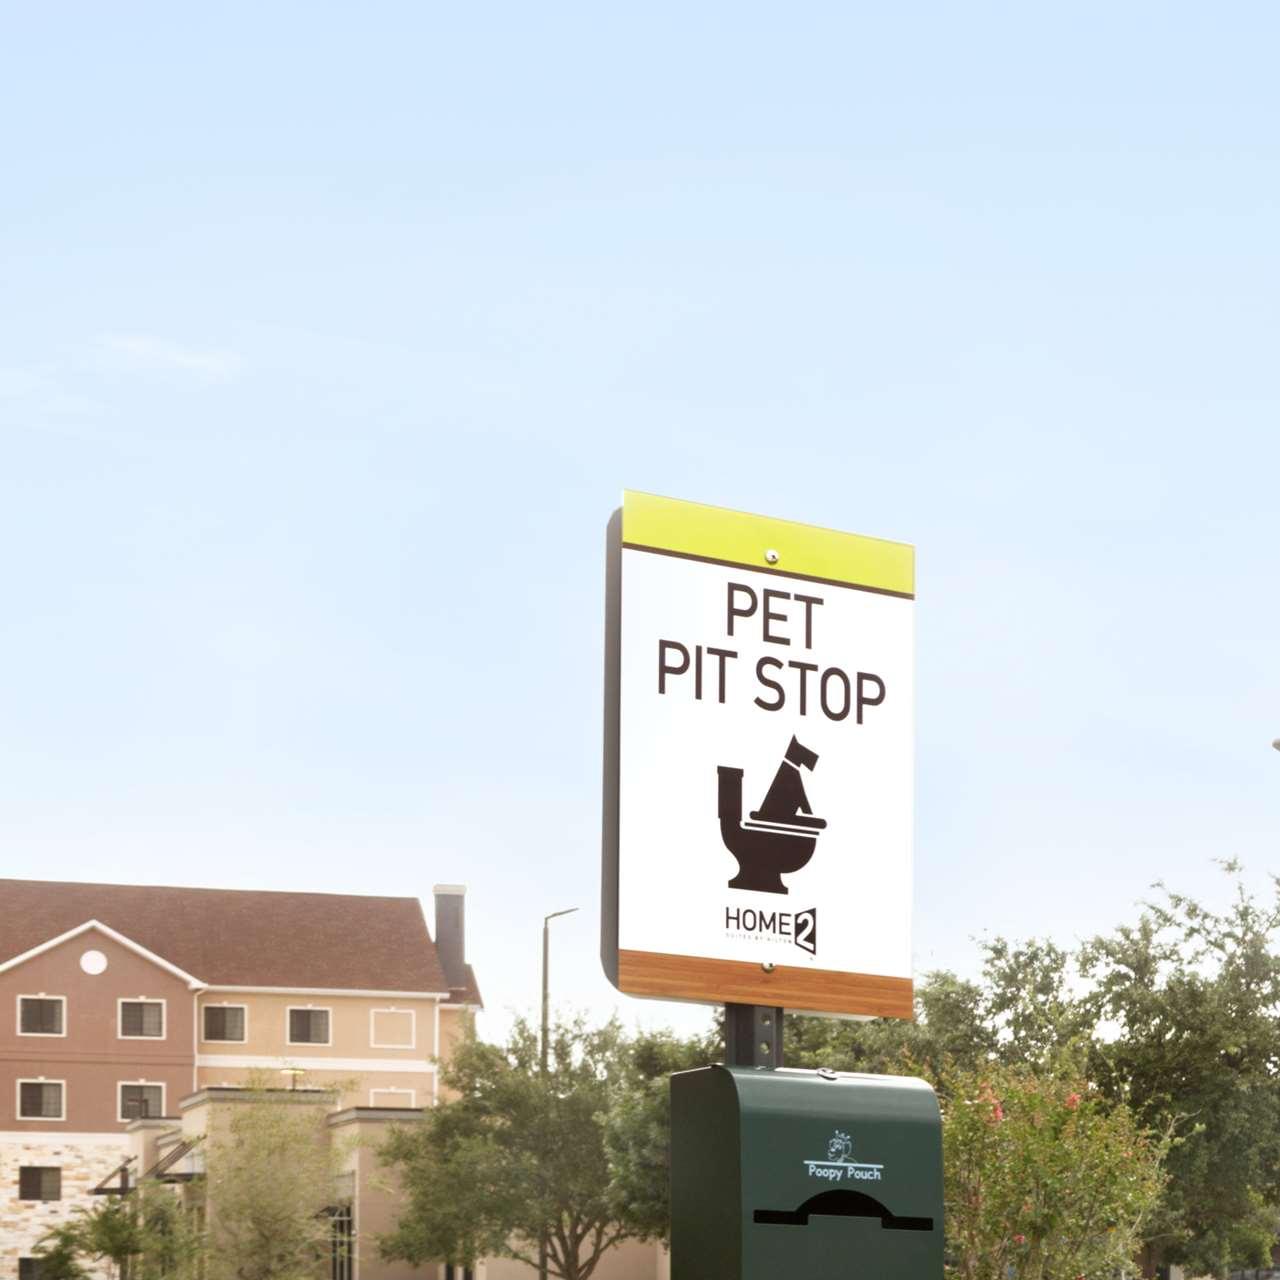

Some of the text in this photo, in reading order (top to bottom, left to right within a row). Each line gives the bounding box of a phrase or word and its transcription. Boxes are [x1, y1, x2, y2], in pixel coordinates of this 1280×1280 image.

[727, 582, 824, 649] PET
[658, 639, 886, 725] PIT STOP
[808, 1164, 881, 1181] Poopy Pouch
